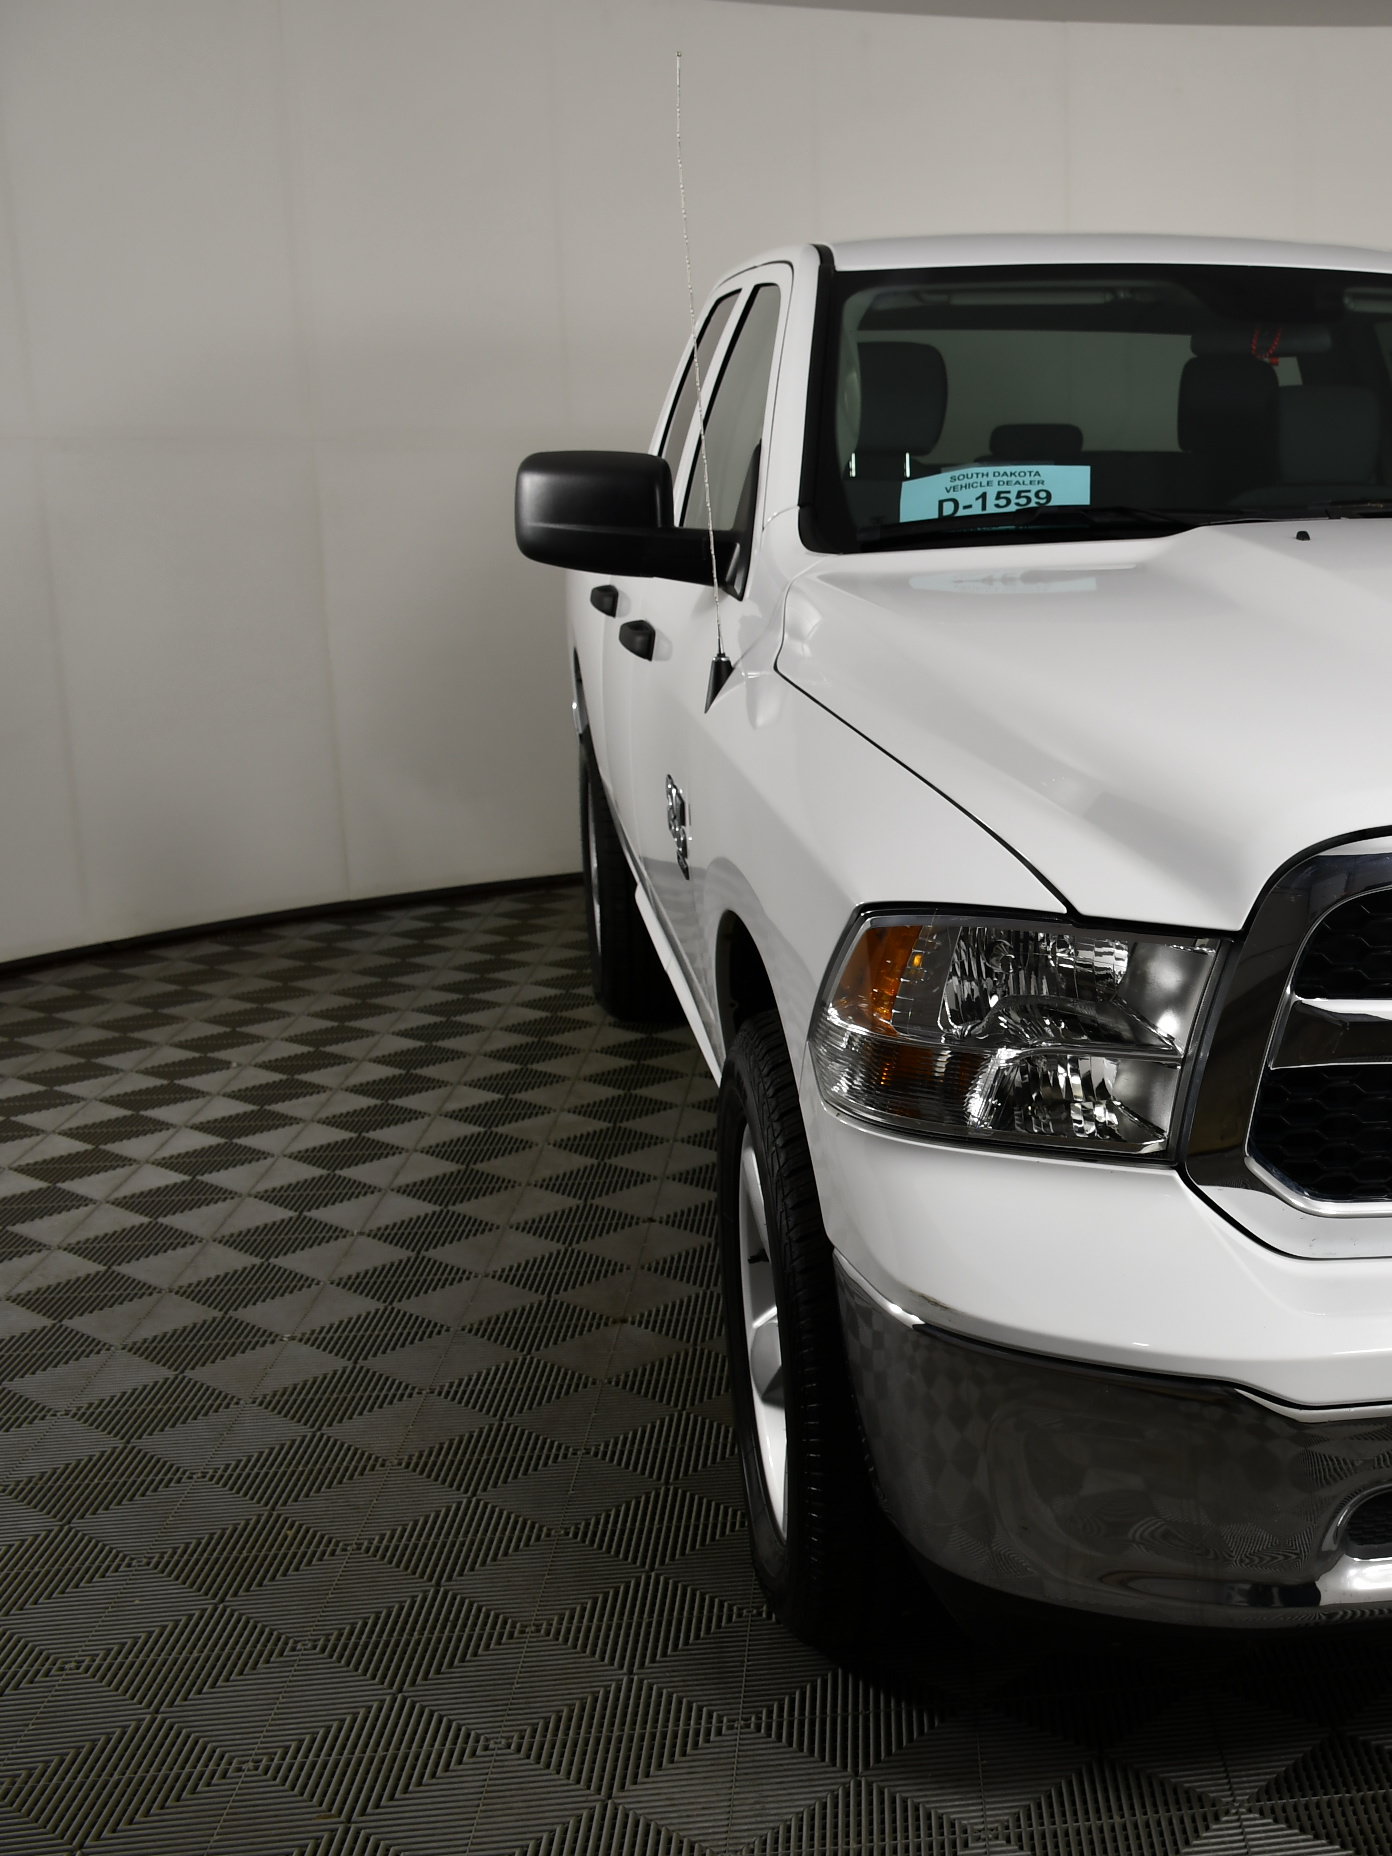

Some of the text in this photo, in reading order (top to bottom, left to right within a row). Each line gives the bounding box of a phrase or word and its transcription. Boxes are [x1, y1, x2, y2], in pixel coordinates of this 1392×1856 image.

[949, 470, 1042, 483] SOUTH DAKOTA
[945, 480, 993, 494] VEHICLE
[938, 489, 1053, 518] D-1559
